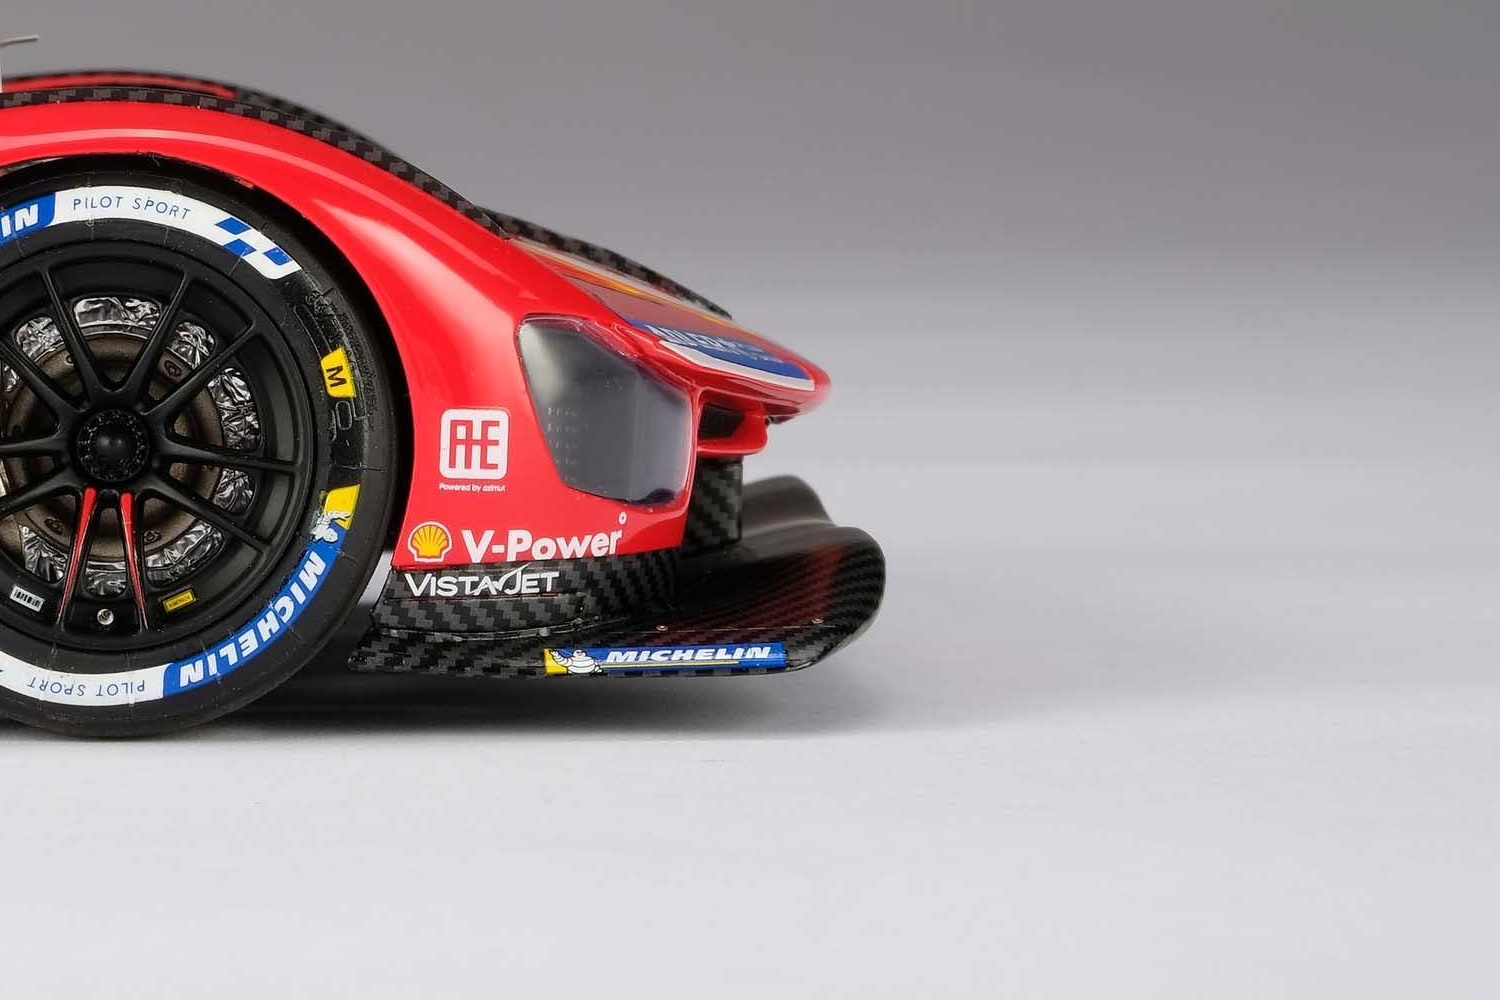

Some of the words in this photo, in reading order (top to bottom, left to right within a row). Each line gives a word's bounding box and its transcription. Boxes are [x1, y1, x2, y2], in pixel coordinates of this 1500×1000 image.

[72, 195, 124, 211] PILOT
[132, 197, 192, 220] SPORT
[439, 482, 471, 492] Powered
[472, 483, 481, 493] by
[461, 528, 623, 563] V-Power
[179, 550, 327, 689] MICHELIN
[605, 645, 772, 664] MICHELIN
[27, 677, 87, 697] SPORT
[96, 679, 146, 697] PILOT
